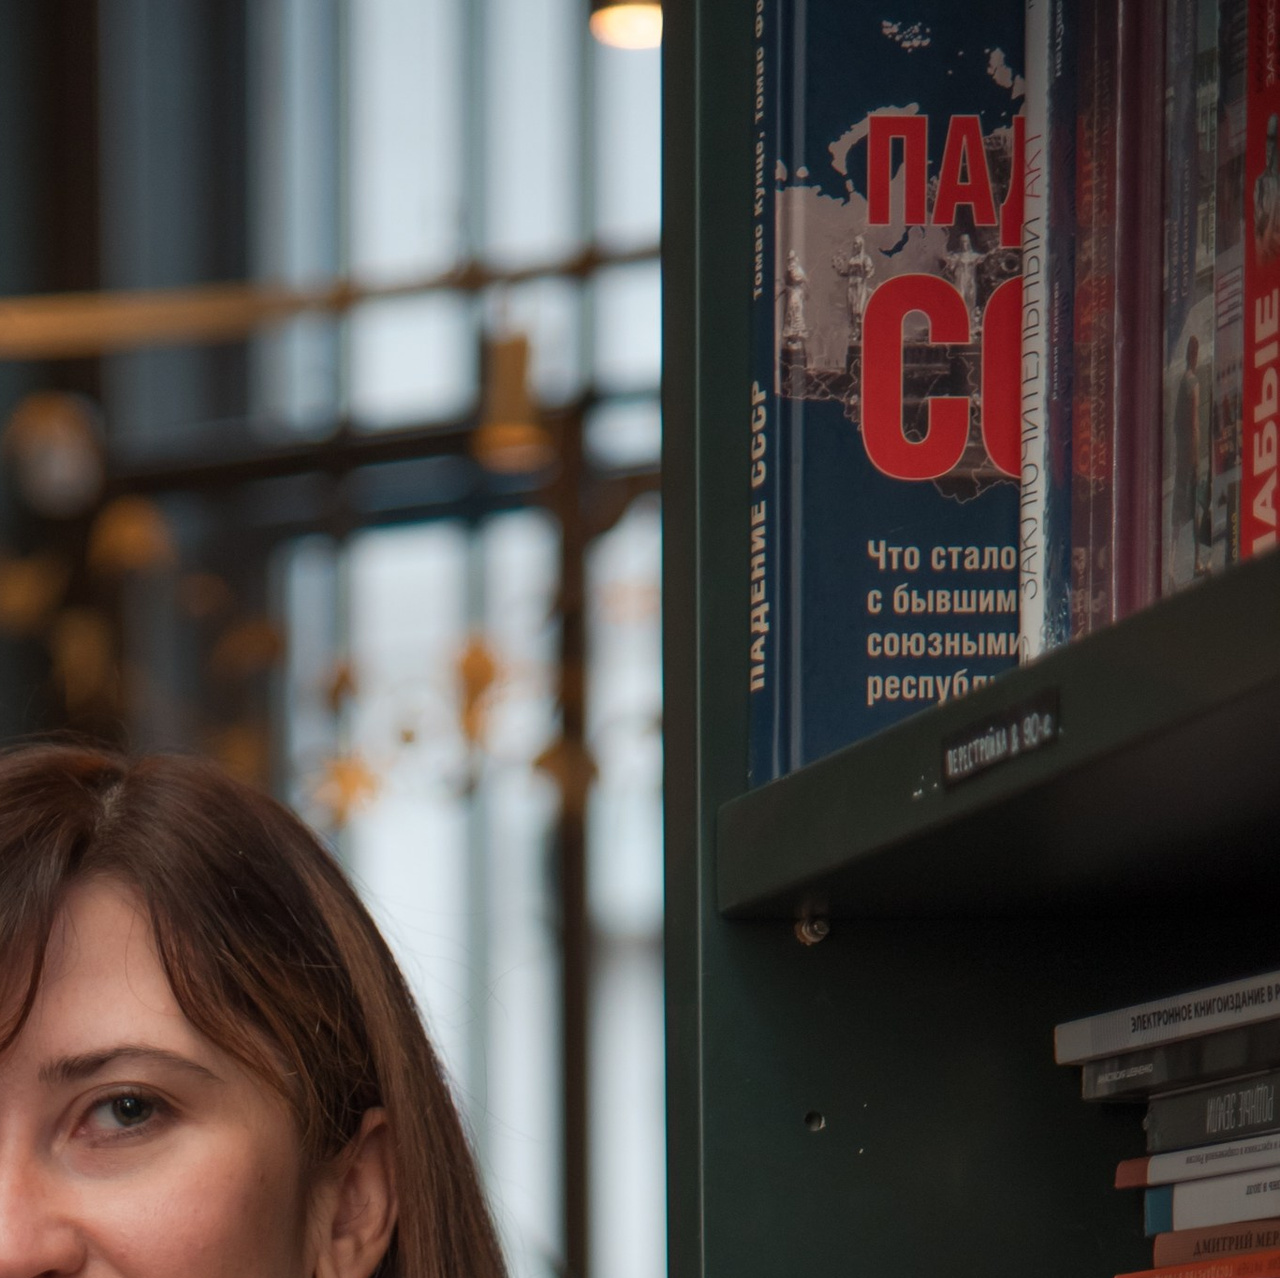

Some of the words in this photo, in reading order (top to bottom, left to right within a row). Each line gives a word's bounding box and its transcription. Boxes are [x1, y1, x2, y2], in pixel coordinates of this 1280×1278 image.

[750, 379, 768, 489] СССР
[868, 540, 920, 570] Что
[931, 546, 1017, 570] стало
[750, 499, 769, 692] ПАДЕНИЕ
[867, 589, 882, 613] с
[893, 582, 1017, 613] бывшим
[1130, 1003, 1193, 1033] ЭЛЕКТРОННОЕ
[1193, 987, 1266, 1018] КНИГОИЗДАНИЕ
[1193, 1230, 1254, 1257] ДМИТРИЙ
